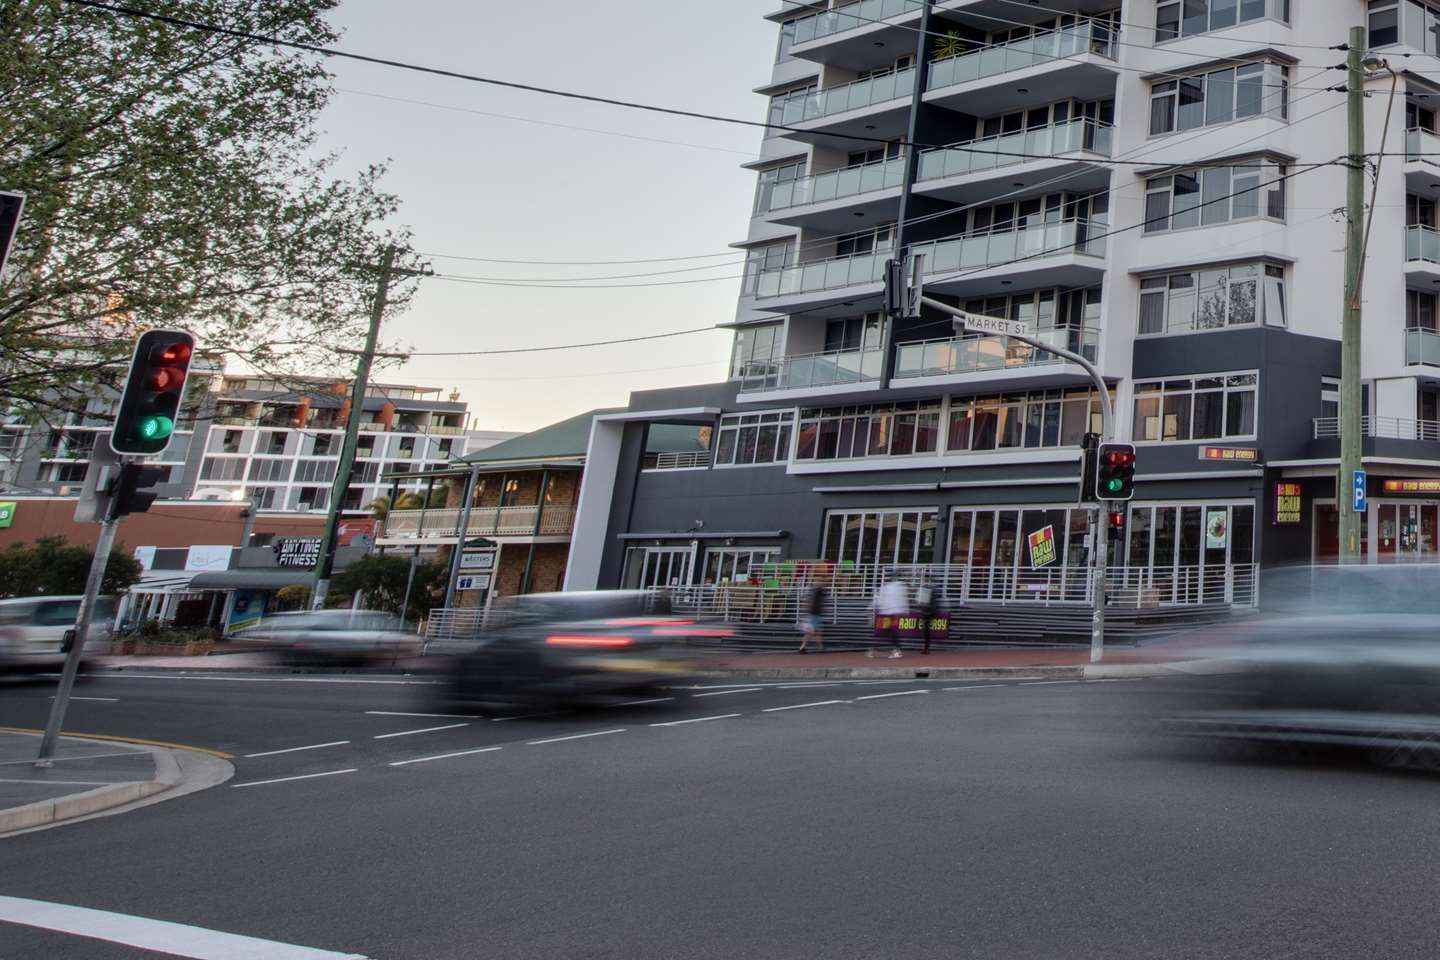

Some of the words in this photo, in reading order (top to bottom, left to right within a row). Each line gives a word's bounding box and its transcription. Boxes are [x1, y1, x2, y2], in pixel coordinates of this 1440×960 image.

[968, 317, 1010, 333] MARKET
[1015, 324, 1026, 335] ST
[1355, 487, 1364, 507] P
[281, 539, 321, 553] ANYTIME
[279, 553, 318, 566] FITNESS
